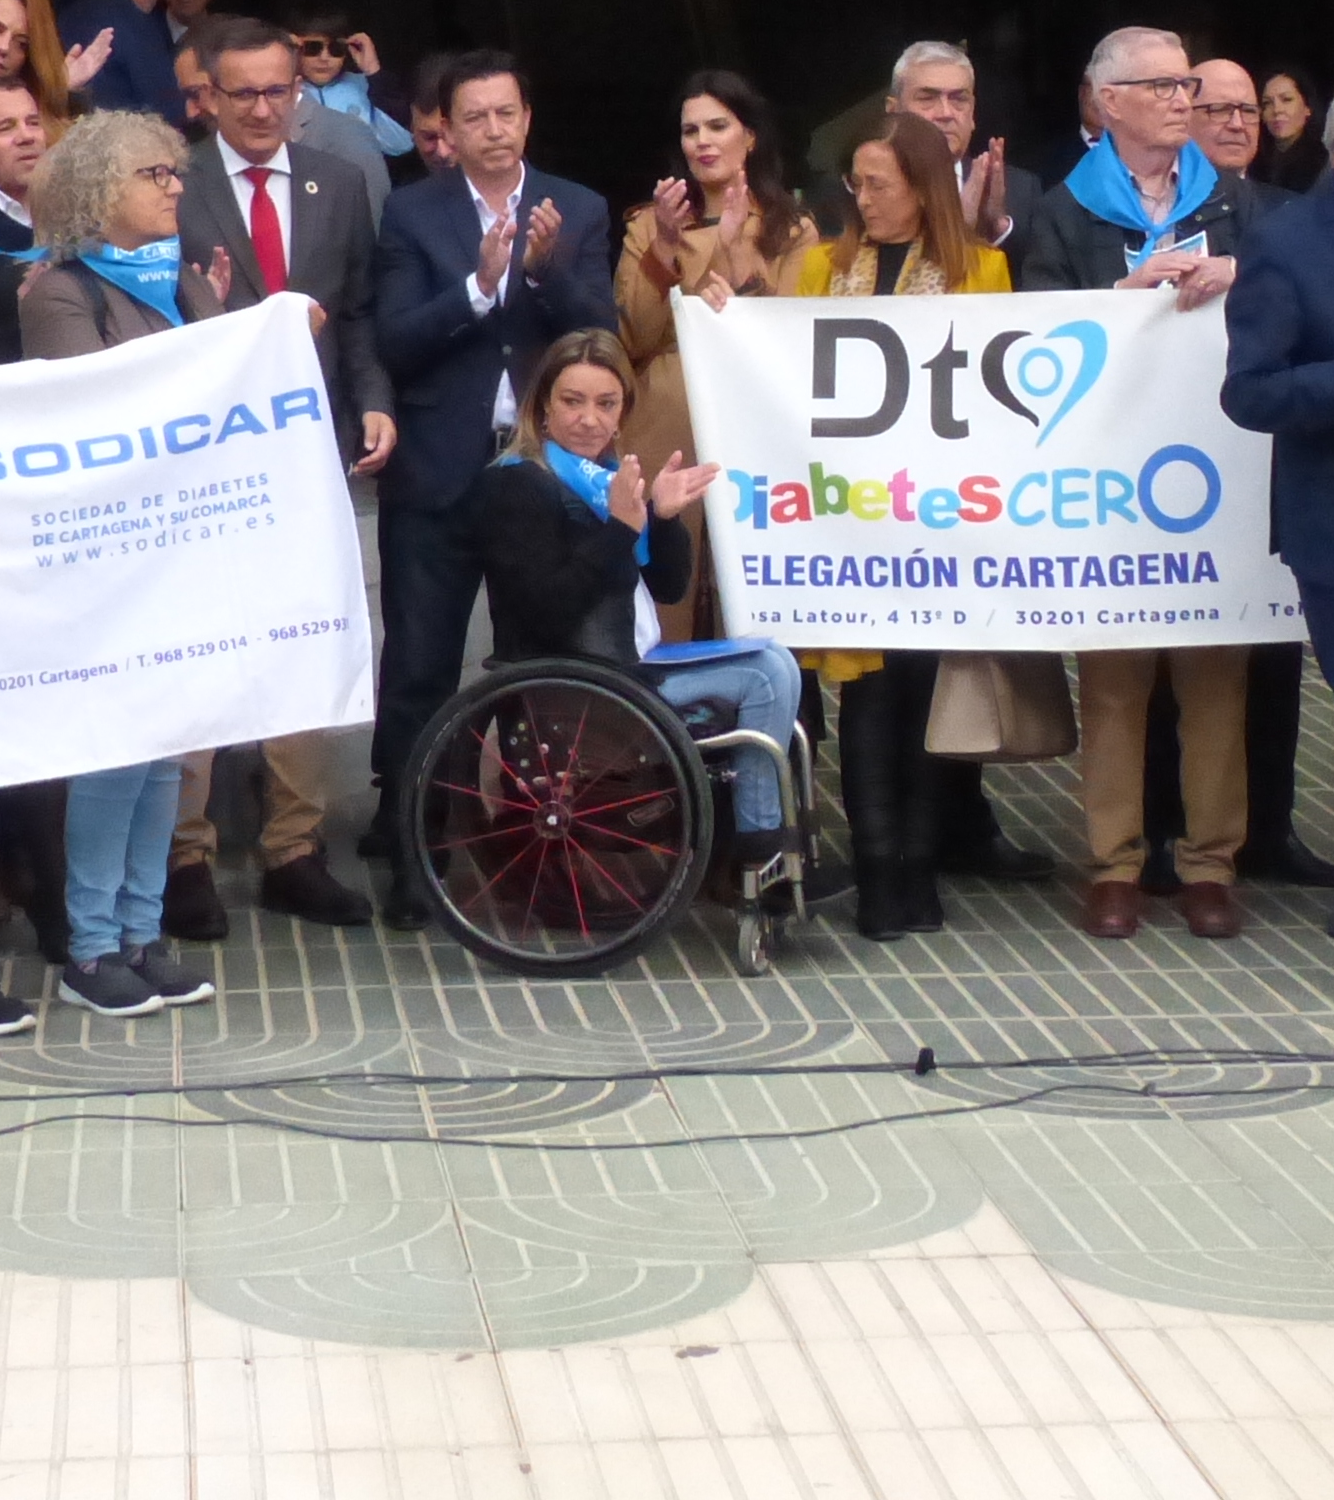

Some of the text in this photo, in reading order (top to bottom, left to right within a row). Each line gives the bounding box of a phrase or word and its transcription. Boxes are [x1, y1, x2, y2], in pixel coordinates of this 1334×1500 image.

[31, 473, 268, 527] SOCIEDAD DE DIABETES
[33, 493, 271, 547] DE CARTAGENA Y SU COMARCA
[36, 512, 276, 568] www.sodicar.es
[973, 551, 1219, 588] CARTAGENA
[751, 610, 782, 623] sa
[793, 609, 876, 627] Latour,
[887, 610, 899, 623] 4
[954, 610, 966, 624] D
[1016, 610, 1085, 625] 30201
[1097, 607, 1220, 626] Cartagena
[39, 663, 118, 685] Cartagena
[137, 655, 152, 668] T.
[153, 649, 183, 665] 968
[187, 642, 215, 658] 529
[219, 636, 248, 652] 014
[268, 625, 298, 642] 968
[302, 619, 330, 635] 529
